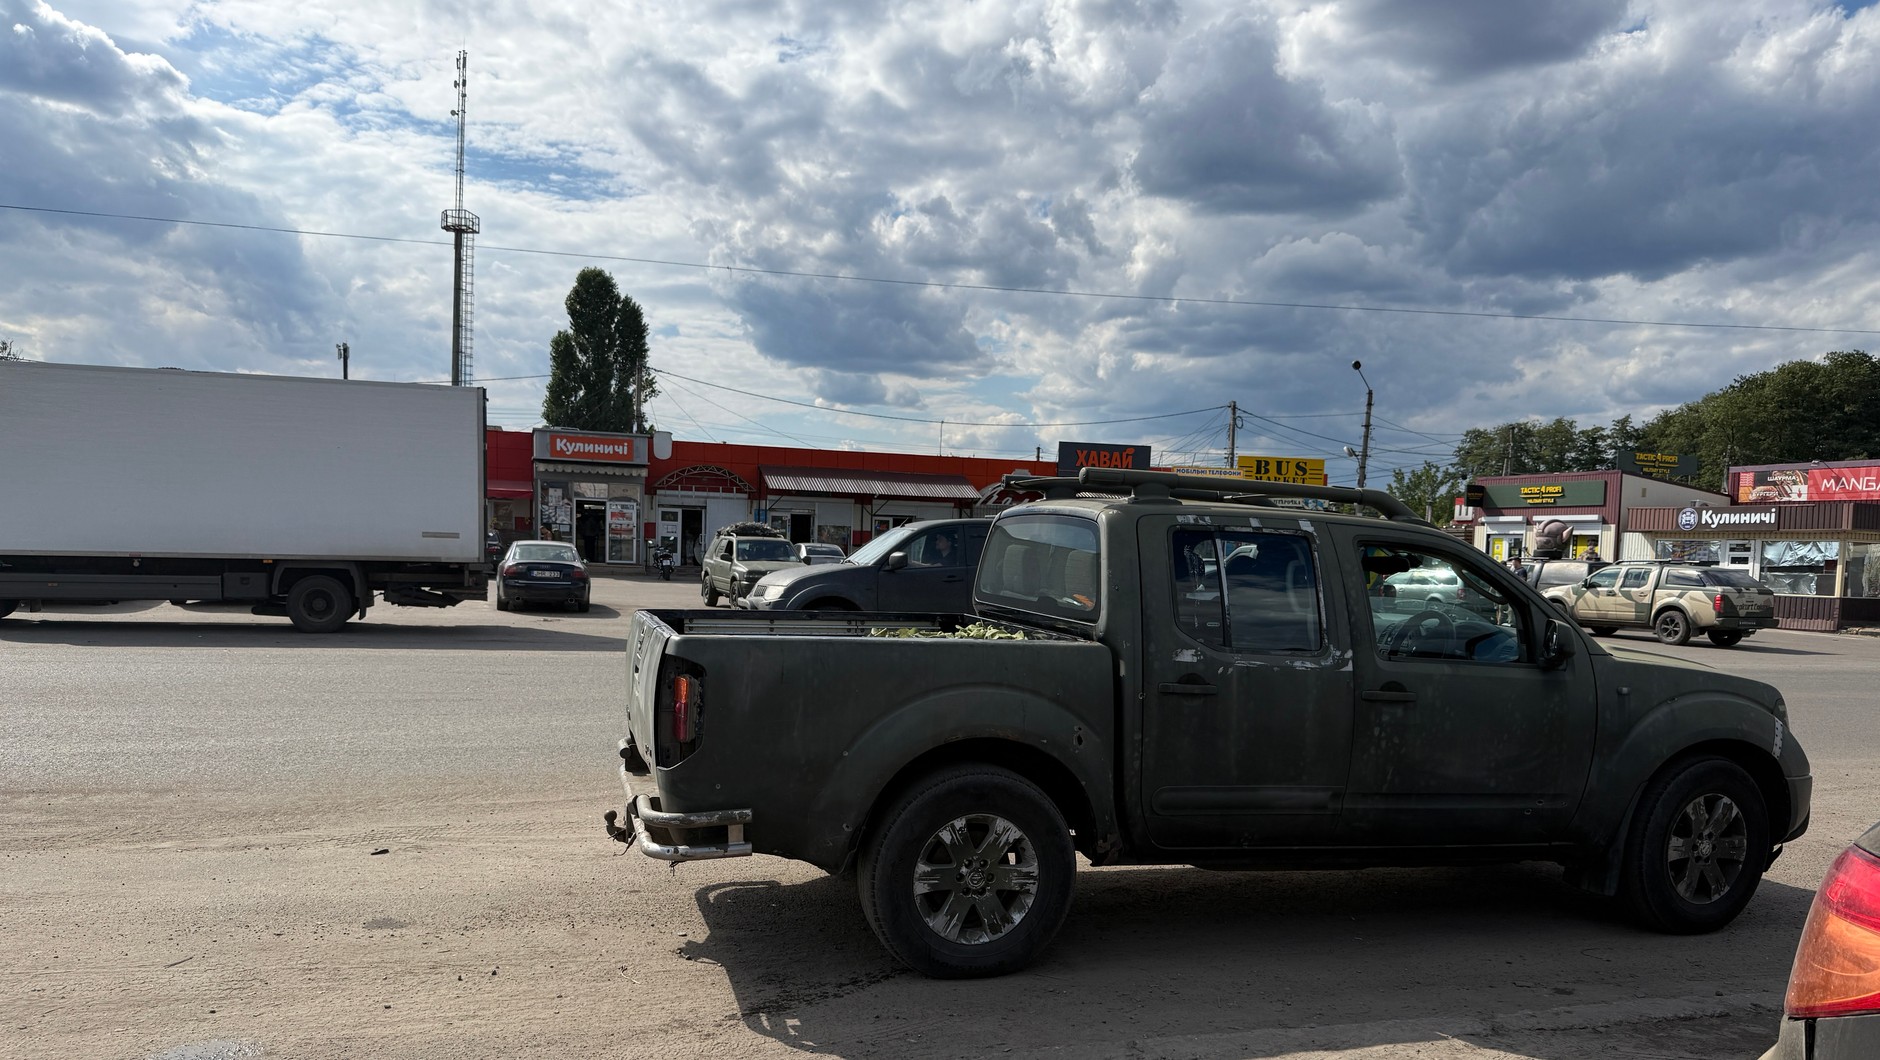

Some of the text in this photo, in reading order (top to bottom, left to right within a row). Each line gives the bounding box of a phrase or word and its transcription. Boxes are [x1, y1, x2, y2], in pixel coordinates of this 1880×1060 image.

[556, 438, 628, 455] Кулиничі
[1075, 447, 1135, 469] ХАВАЙ
[1635, 452, 1656, 461] TACTIC
[1254, 459, 1308, 477] BUS
[1520, 486, 1540, 494] TACTIC
[1540, 485, 1546, 493] 4
[1701, 507, 1776, 529] Кулиничі
